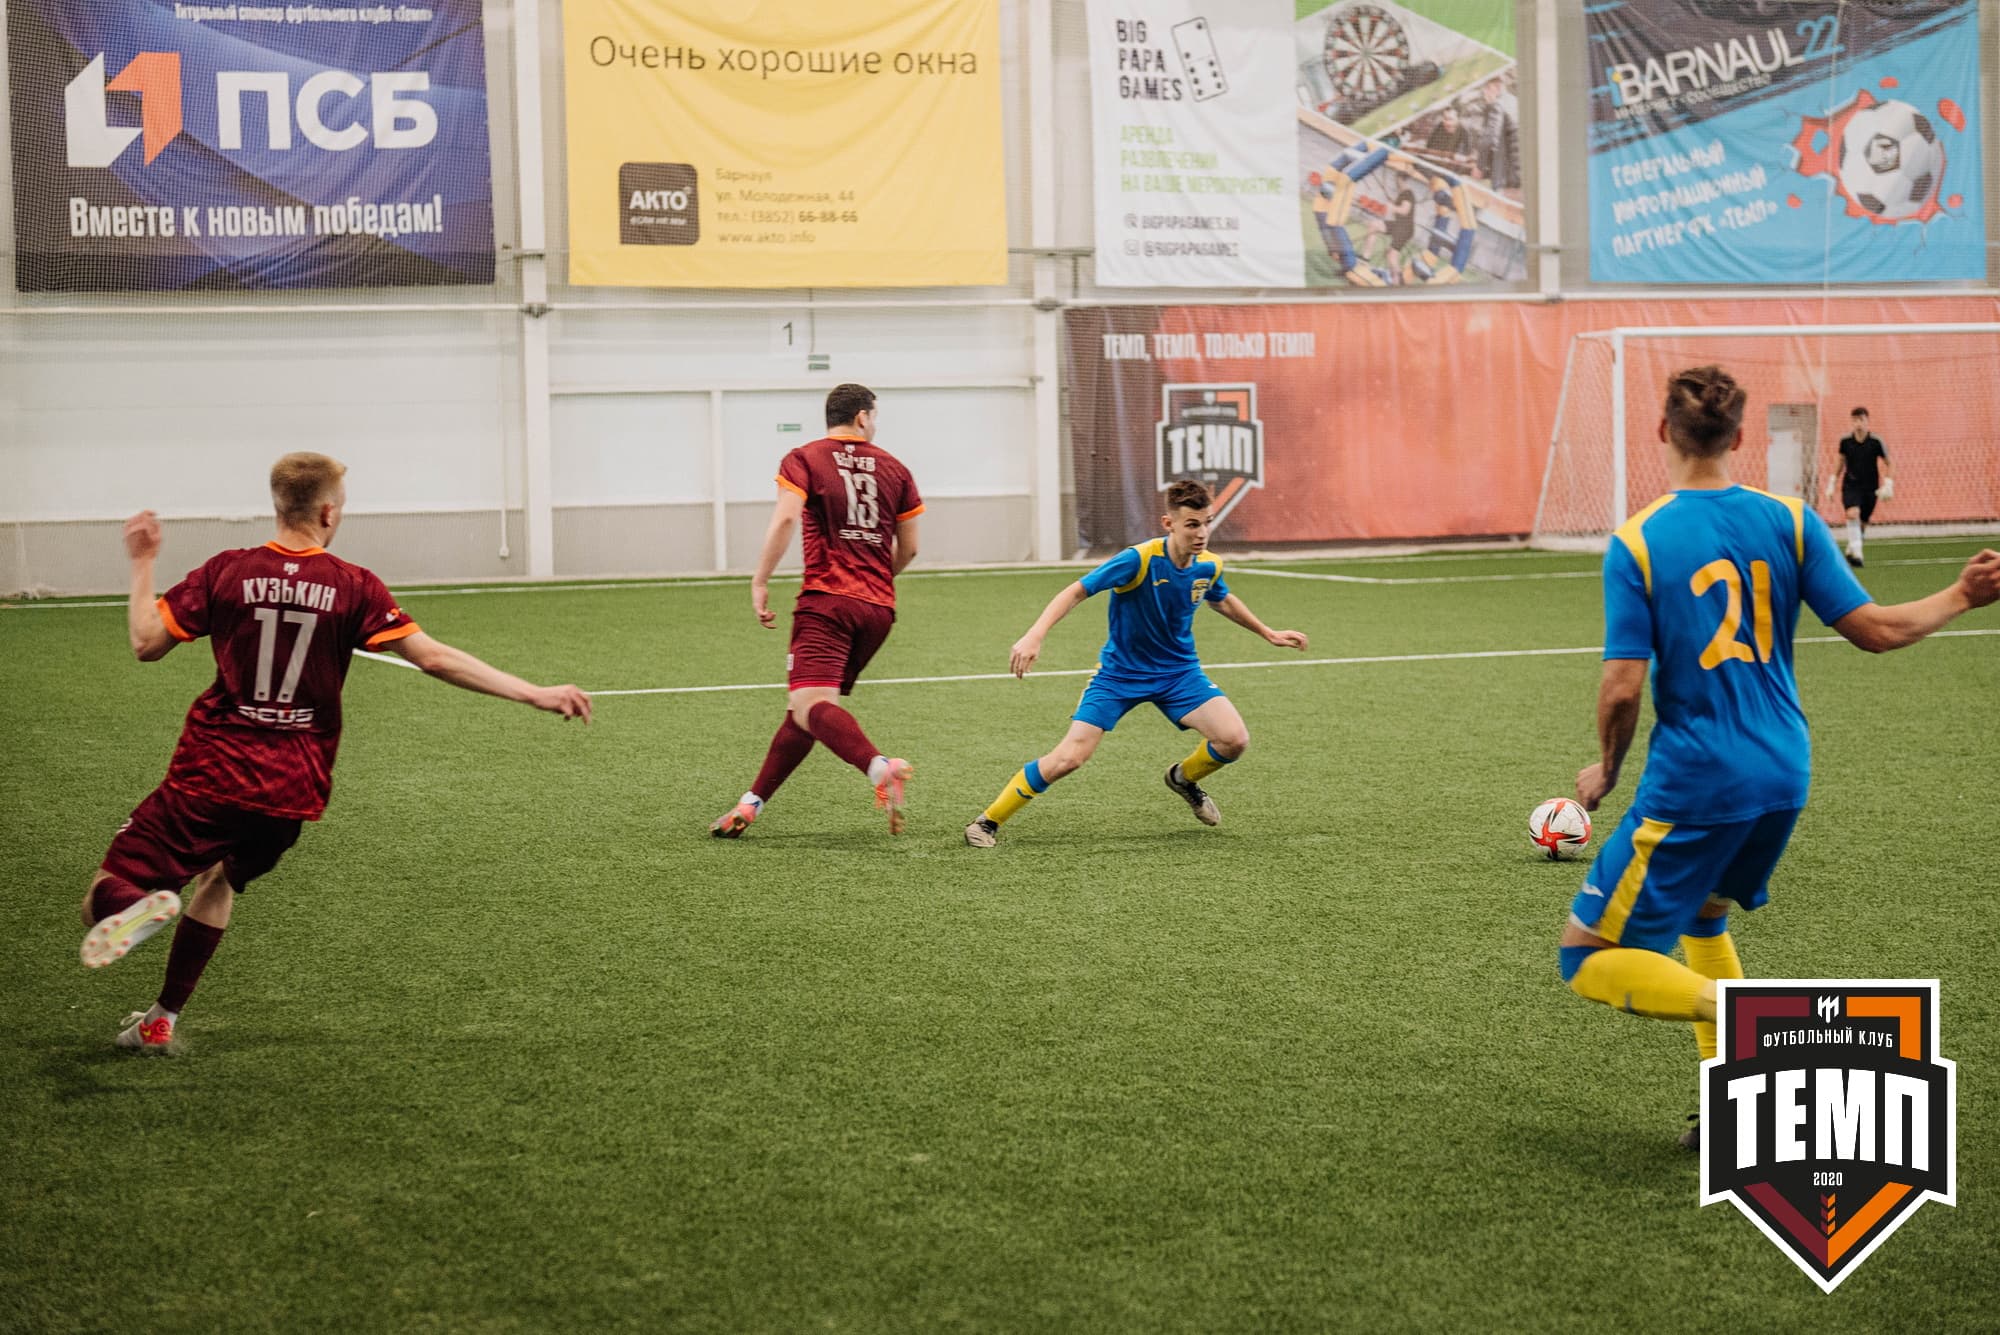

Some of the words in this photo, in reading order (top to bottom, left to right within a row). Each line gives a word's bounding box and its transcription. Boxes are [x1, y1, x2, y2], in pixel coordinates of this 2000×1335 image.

[1116, 19, 1147, 43] BIG
[590, 36, 705, 70] Очень
[718, 48, 882, 80] хорошие
[893, 52, 977, 75] окна
[1118, 48, 1166, 72] PAPA
[1119, 75, 1182, 101] GAMES
[217, 70, 439, 151] ПСБ
[629, 190, 688, 211] АКТО
[838, 190, 856, 201] 44
[69, 197, 176, 237] Вместе
[183, 206, 201, 237] к
[208, 205, 306, 237] новым
[313, 194, 443, 239] победам!
[782, 321, 793, 346] 1
[1103, 334, 1149, 361] ТЕМП,
[1154, 334, 1201, 360] ТЕМП,
[1204, 332, 1266, 359] ТОЛЬКО
[1268, 332, 1316, 358] ТЕМП!
[1167, 424, 1254, 475] ТЕМП
[838, 468, 880, 529] 13
[242, 577, 337, 612] КУЗЬКИН
[1690, 558, 1774, 670] 21
[254, 607, 319, 704] 17
